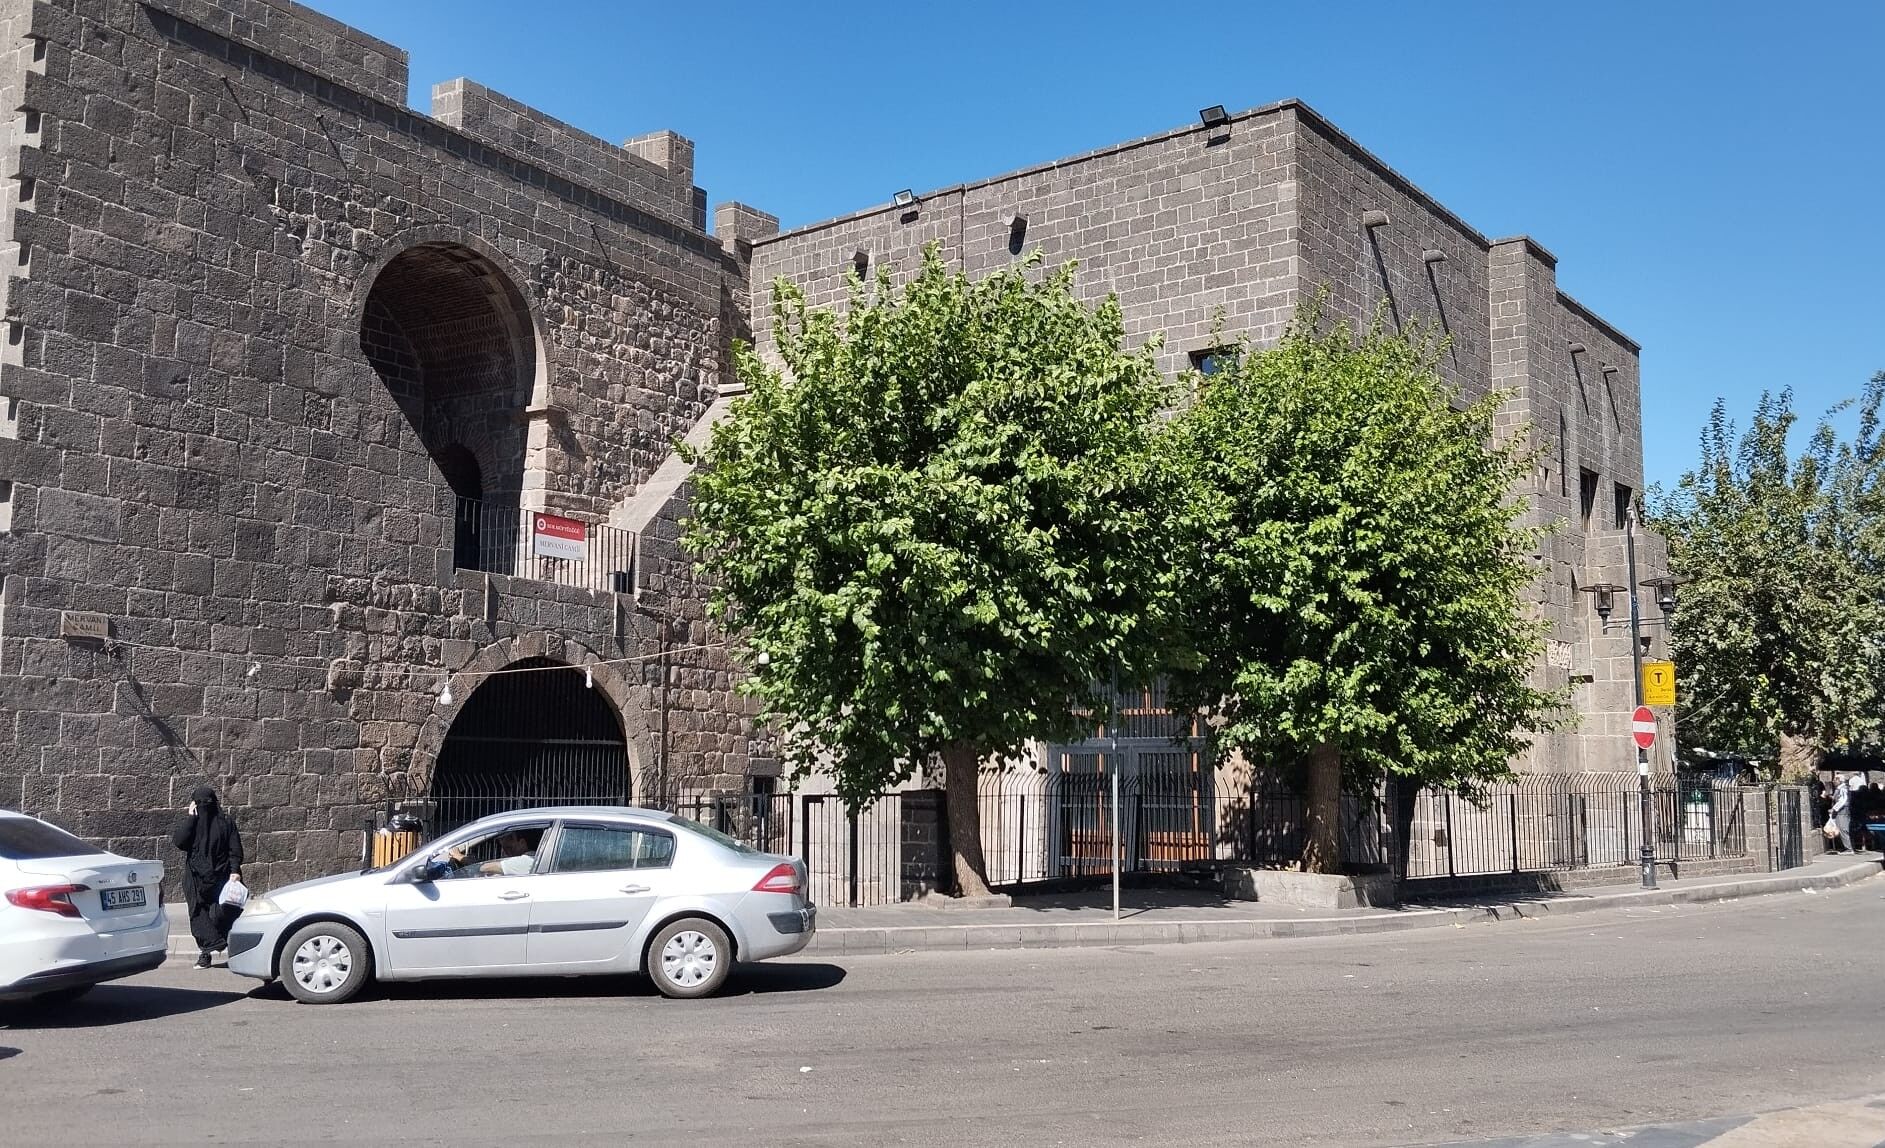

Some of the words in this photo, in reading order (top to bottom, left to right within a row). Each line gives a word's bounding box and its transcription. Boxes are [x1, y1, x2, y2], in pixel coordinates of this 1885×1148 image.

[1654, 672, 1663, 684] T
[107, 891, 116, 905] 45
[132, 889, 144, 902] 291
